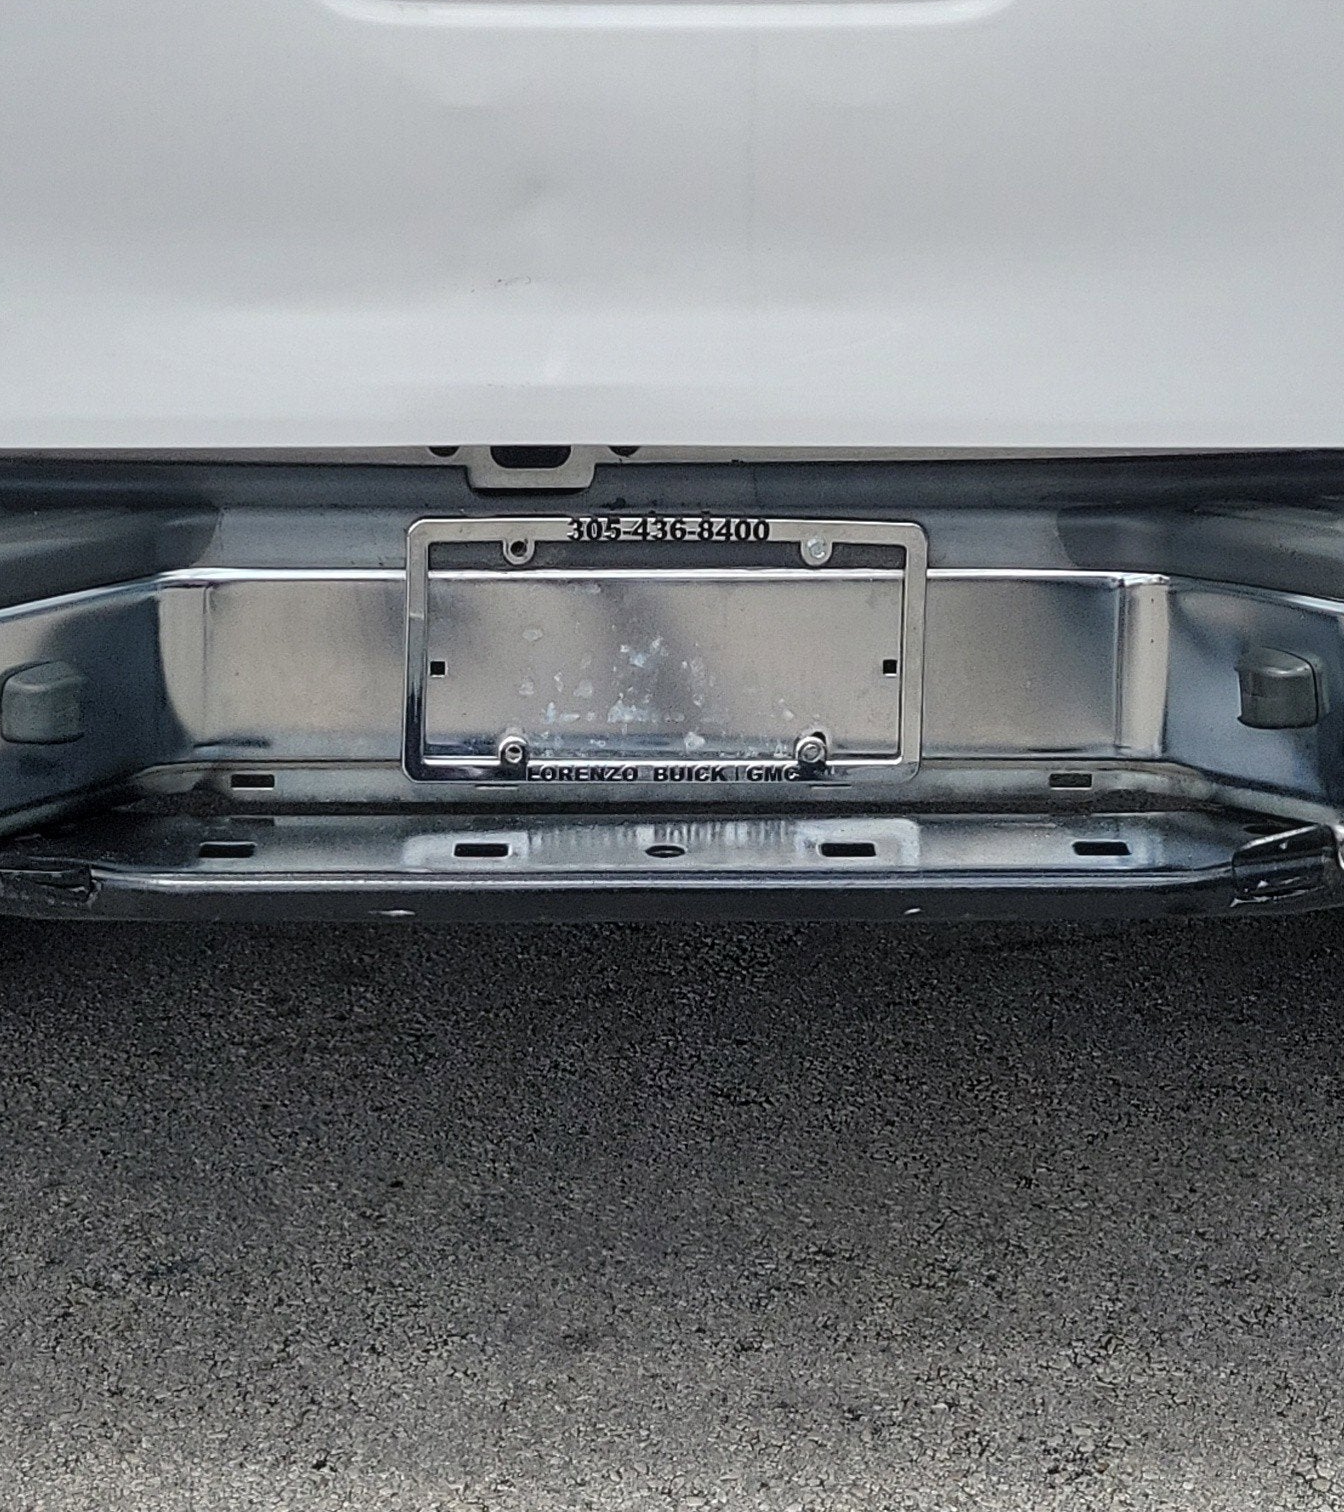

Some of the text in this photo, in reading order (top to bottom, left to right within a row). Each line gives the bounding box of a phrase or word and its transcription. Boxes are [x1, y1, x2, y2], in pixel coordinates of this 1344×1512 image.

[567, 517, 771, 542] 305-436-8400
[526, 765, 800, 782] LORENZO BUICK GMC
